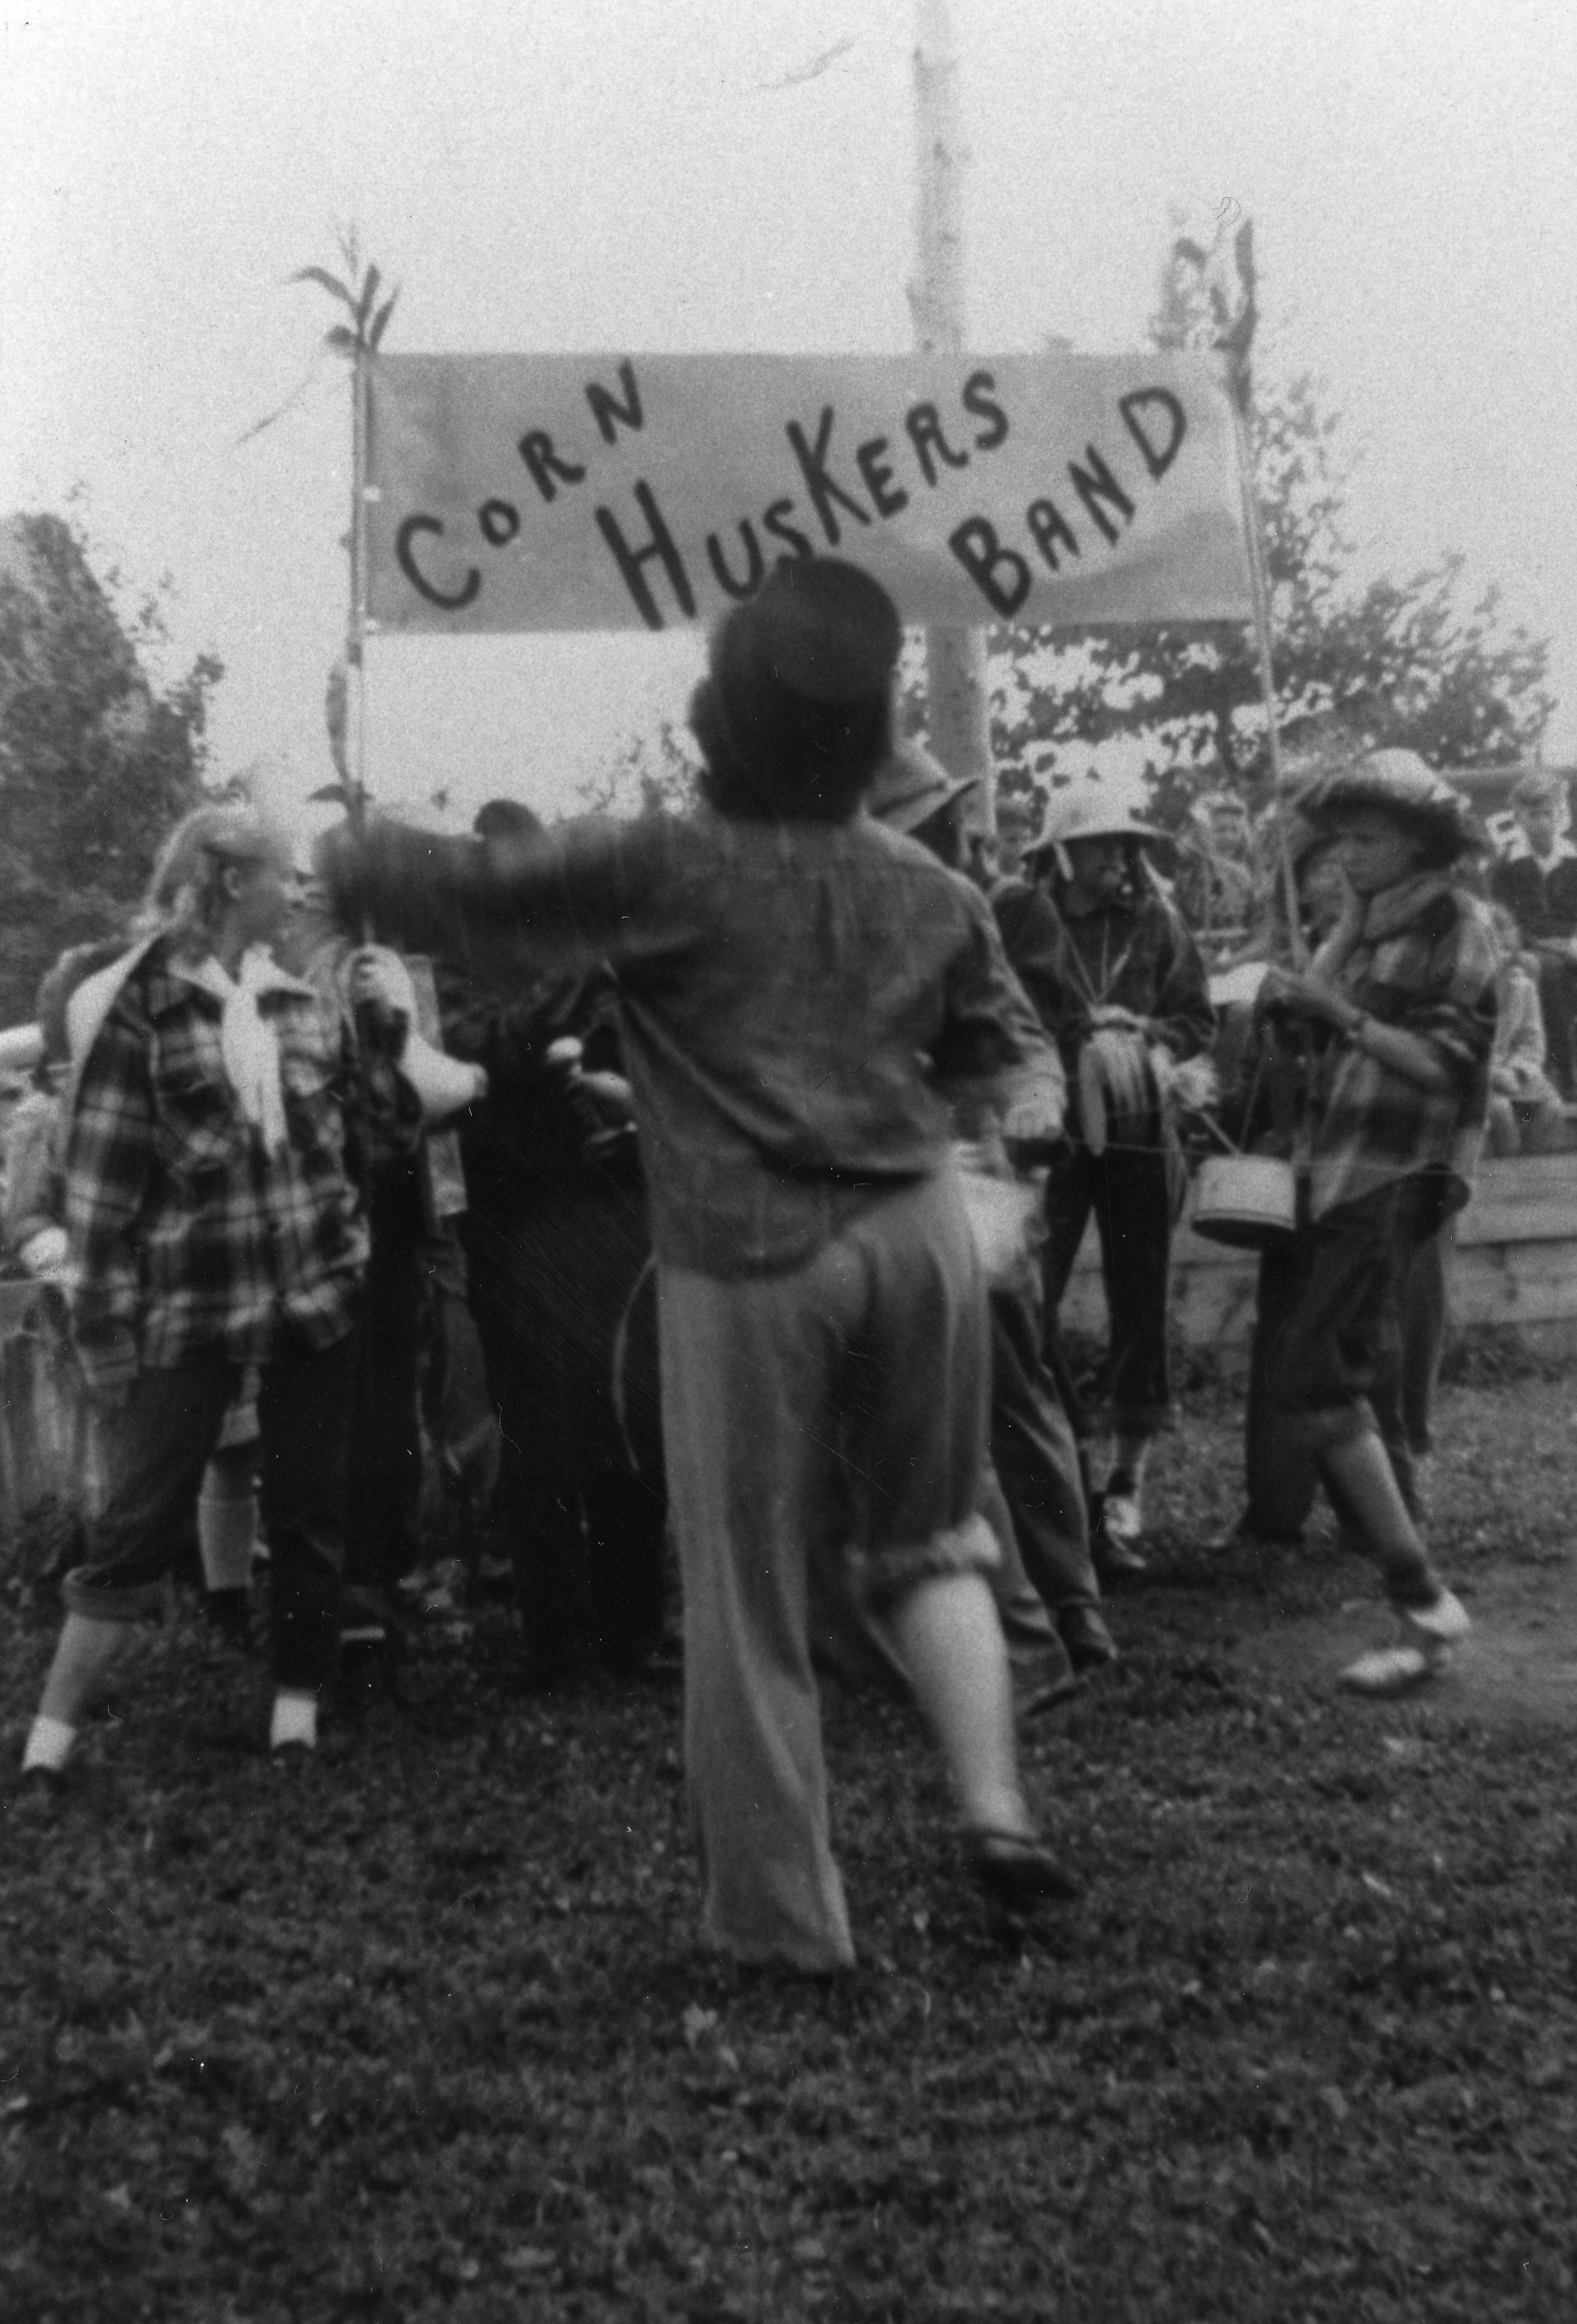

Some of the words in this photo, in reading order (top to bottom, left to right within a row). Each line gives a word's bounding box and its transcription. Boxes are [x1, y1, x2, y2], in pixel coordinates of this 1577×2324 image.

[395, 358, 643, 611] CORN
[594, 369, 1009, 631] HUSKERS
[948, 387, 1187, 619] BAND
